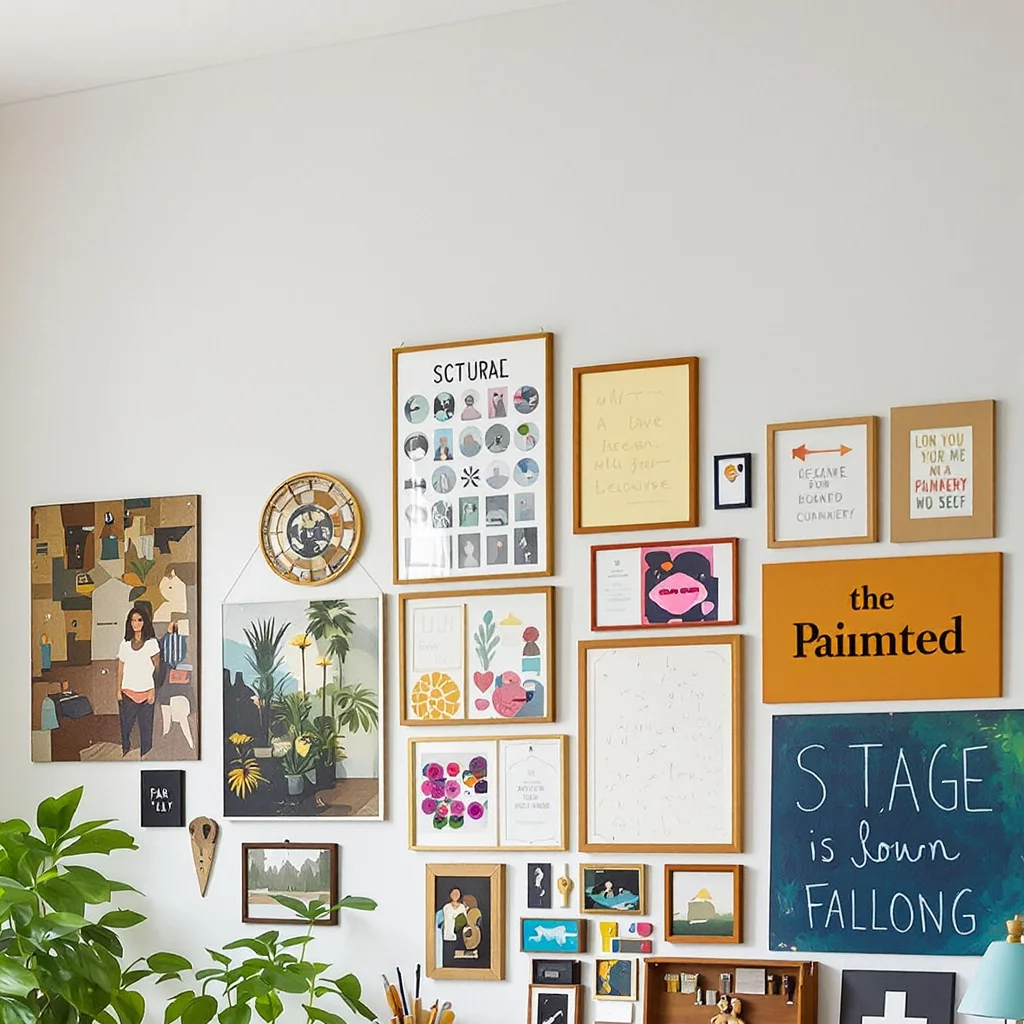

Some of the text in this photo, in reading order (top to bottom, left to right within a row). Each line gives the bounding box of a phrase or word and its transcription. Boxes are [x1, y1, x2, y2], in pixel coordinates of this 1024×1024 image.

[940, 432, 964, 447] YOU
[849, 585, 895, 611] the
[808, 829, 836, 863] is
[804, 882, 977, 936] FALLONG
